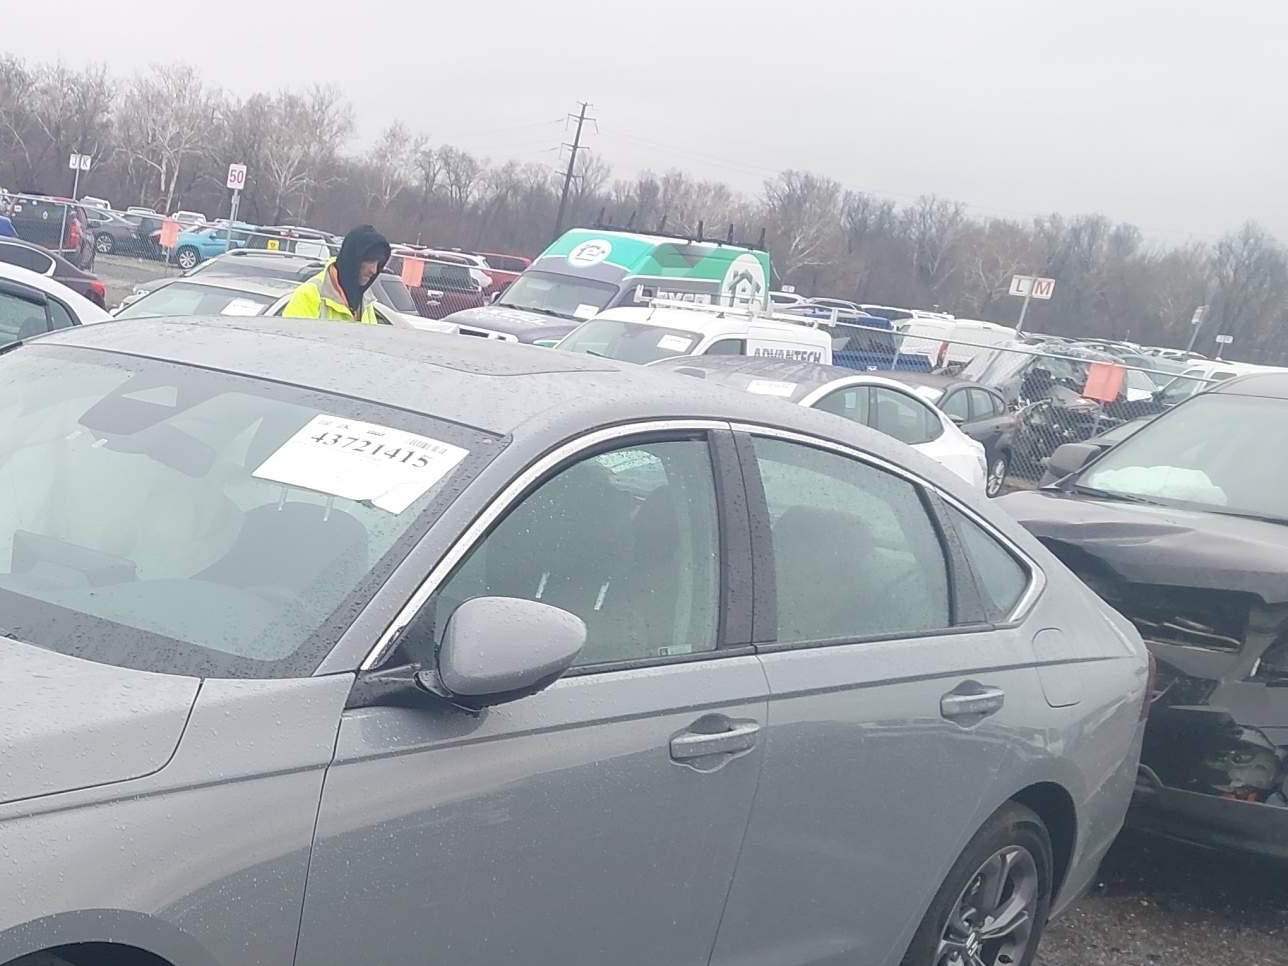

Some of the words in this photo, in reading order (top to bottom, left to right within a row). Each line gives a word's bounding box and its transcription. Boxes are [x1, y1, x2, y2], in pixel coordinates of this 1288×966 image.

[229, 169, 244, 184] 50
[1015, 279, 1025, 293] L
[1034, 280, 1051, 296] M
[311, 431, 431, 469] 43721415
